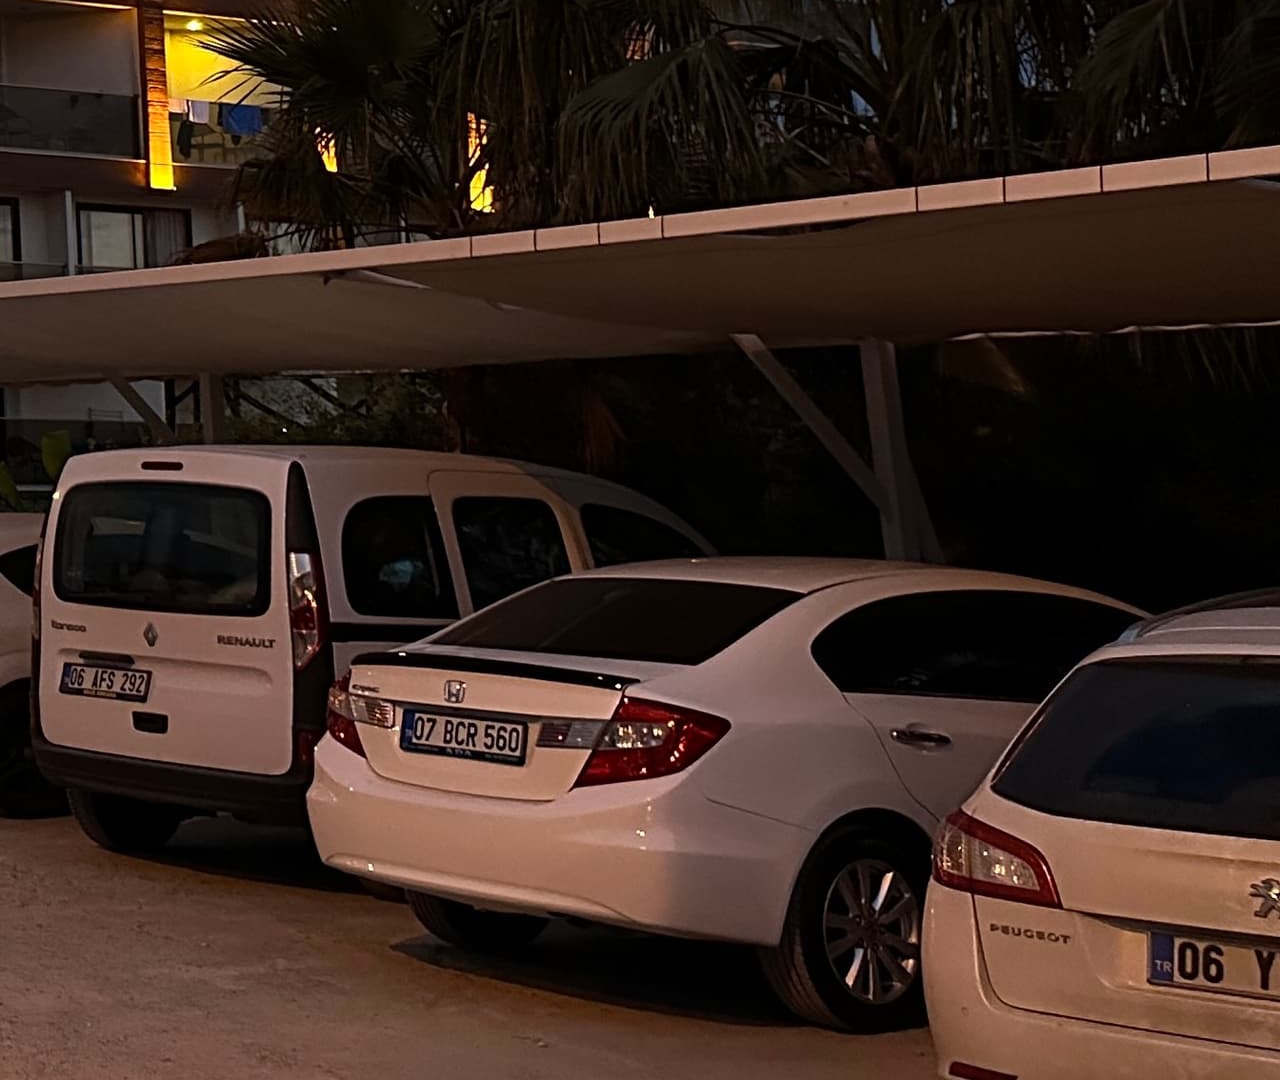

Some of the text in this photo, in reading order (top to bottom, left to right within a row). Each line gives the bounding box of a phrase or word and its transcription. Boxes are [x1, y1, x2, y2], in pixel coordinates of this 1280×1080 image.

[216, 634, 276, 649] RENAULT
[70, 667, 85, 687] 06
[91, 670, 116, 690] AFS
[120, 673, 146, 694] 292
[413, 716, 520, 753] 07 BCR 560
[989, 923, 1072, 945] PEUGEOT
[1154, 959, 1173, 973] TR
[1177, 941, 1276, 991] 06 Y
